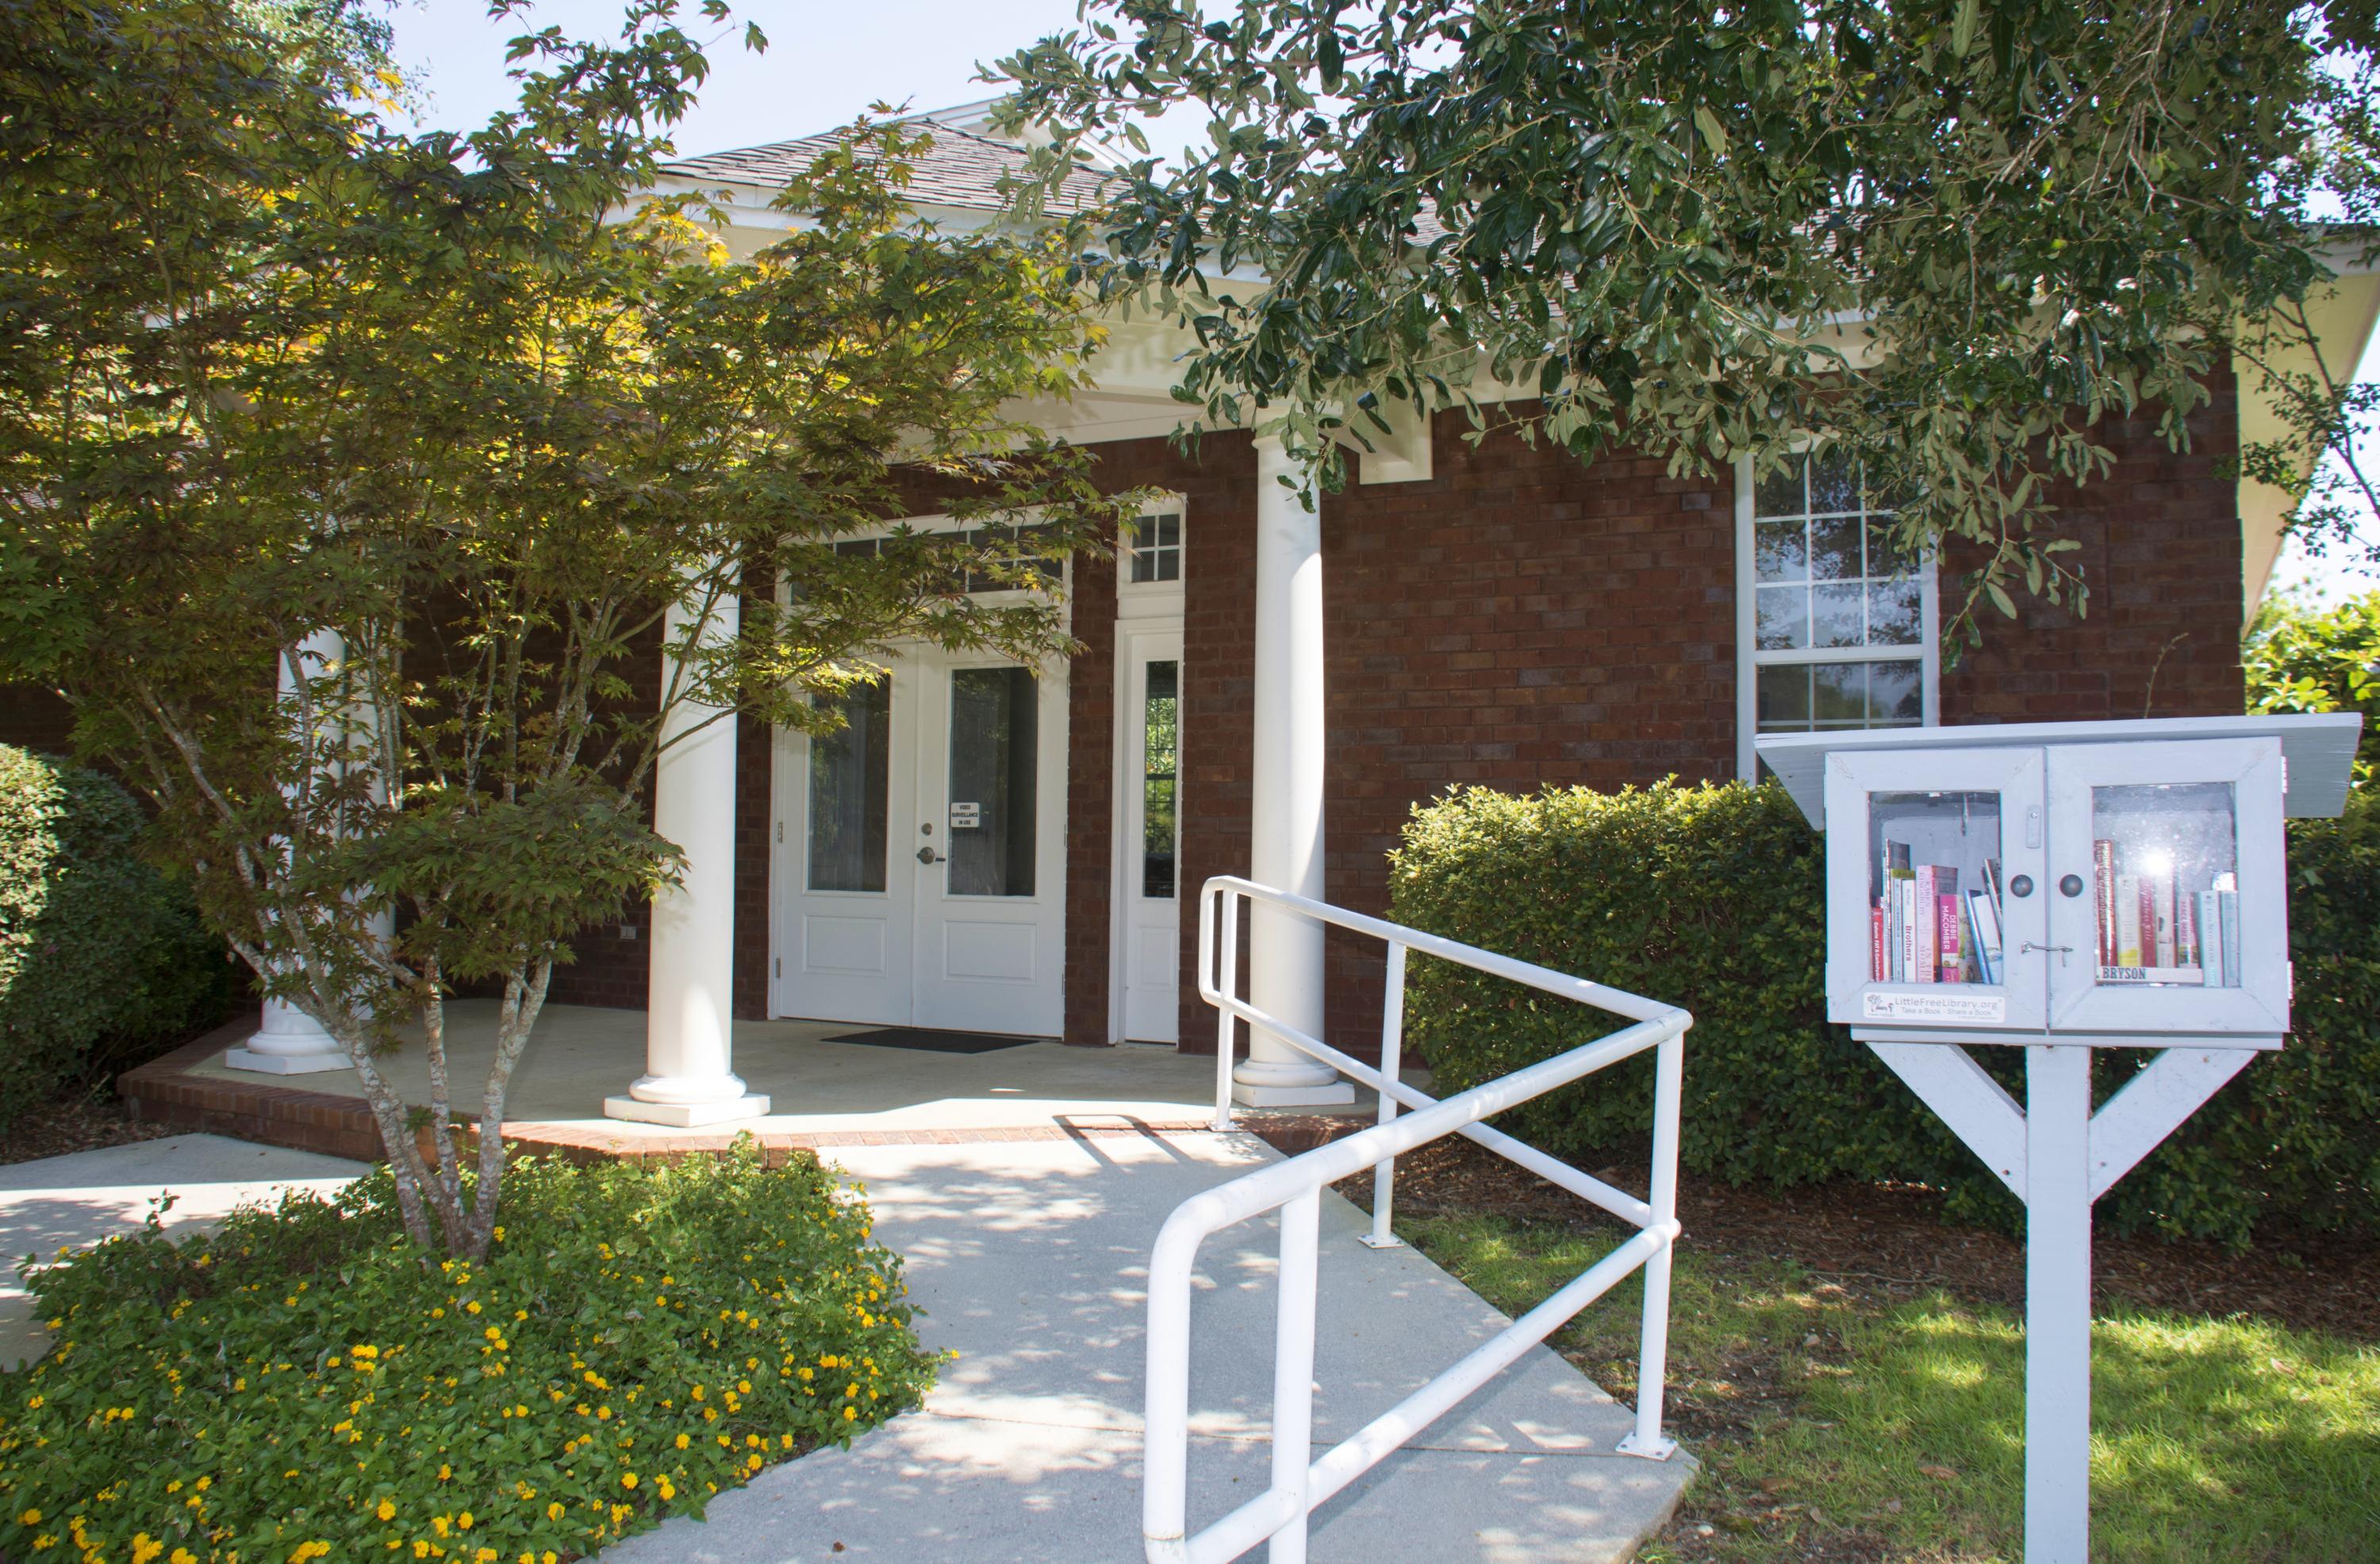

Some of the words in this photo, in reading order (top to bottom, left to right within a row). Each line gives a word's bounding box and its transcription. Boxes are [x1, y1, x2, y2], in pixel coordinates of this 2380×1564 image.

[1940, 905, 1951, 951] MACOMBER
[2102, 968, 2146, 979] BRYSON
[1894, 997, 1998, 1010] LittleFreeLibrary.org
